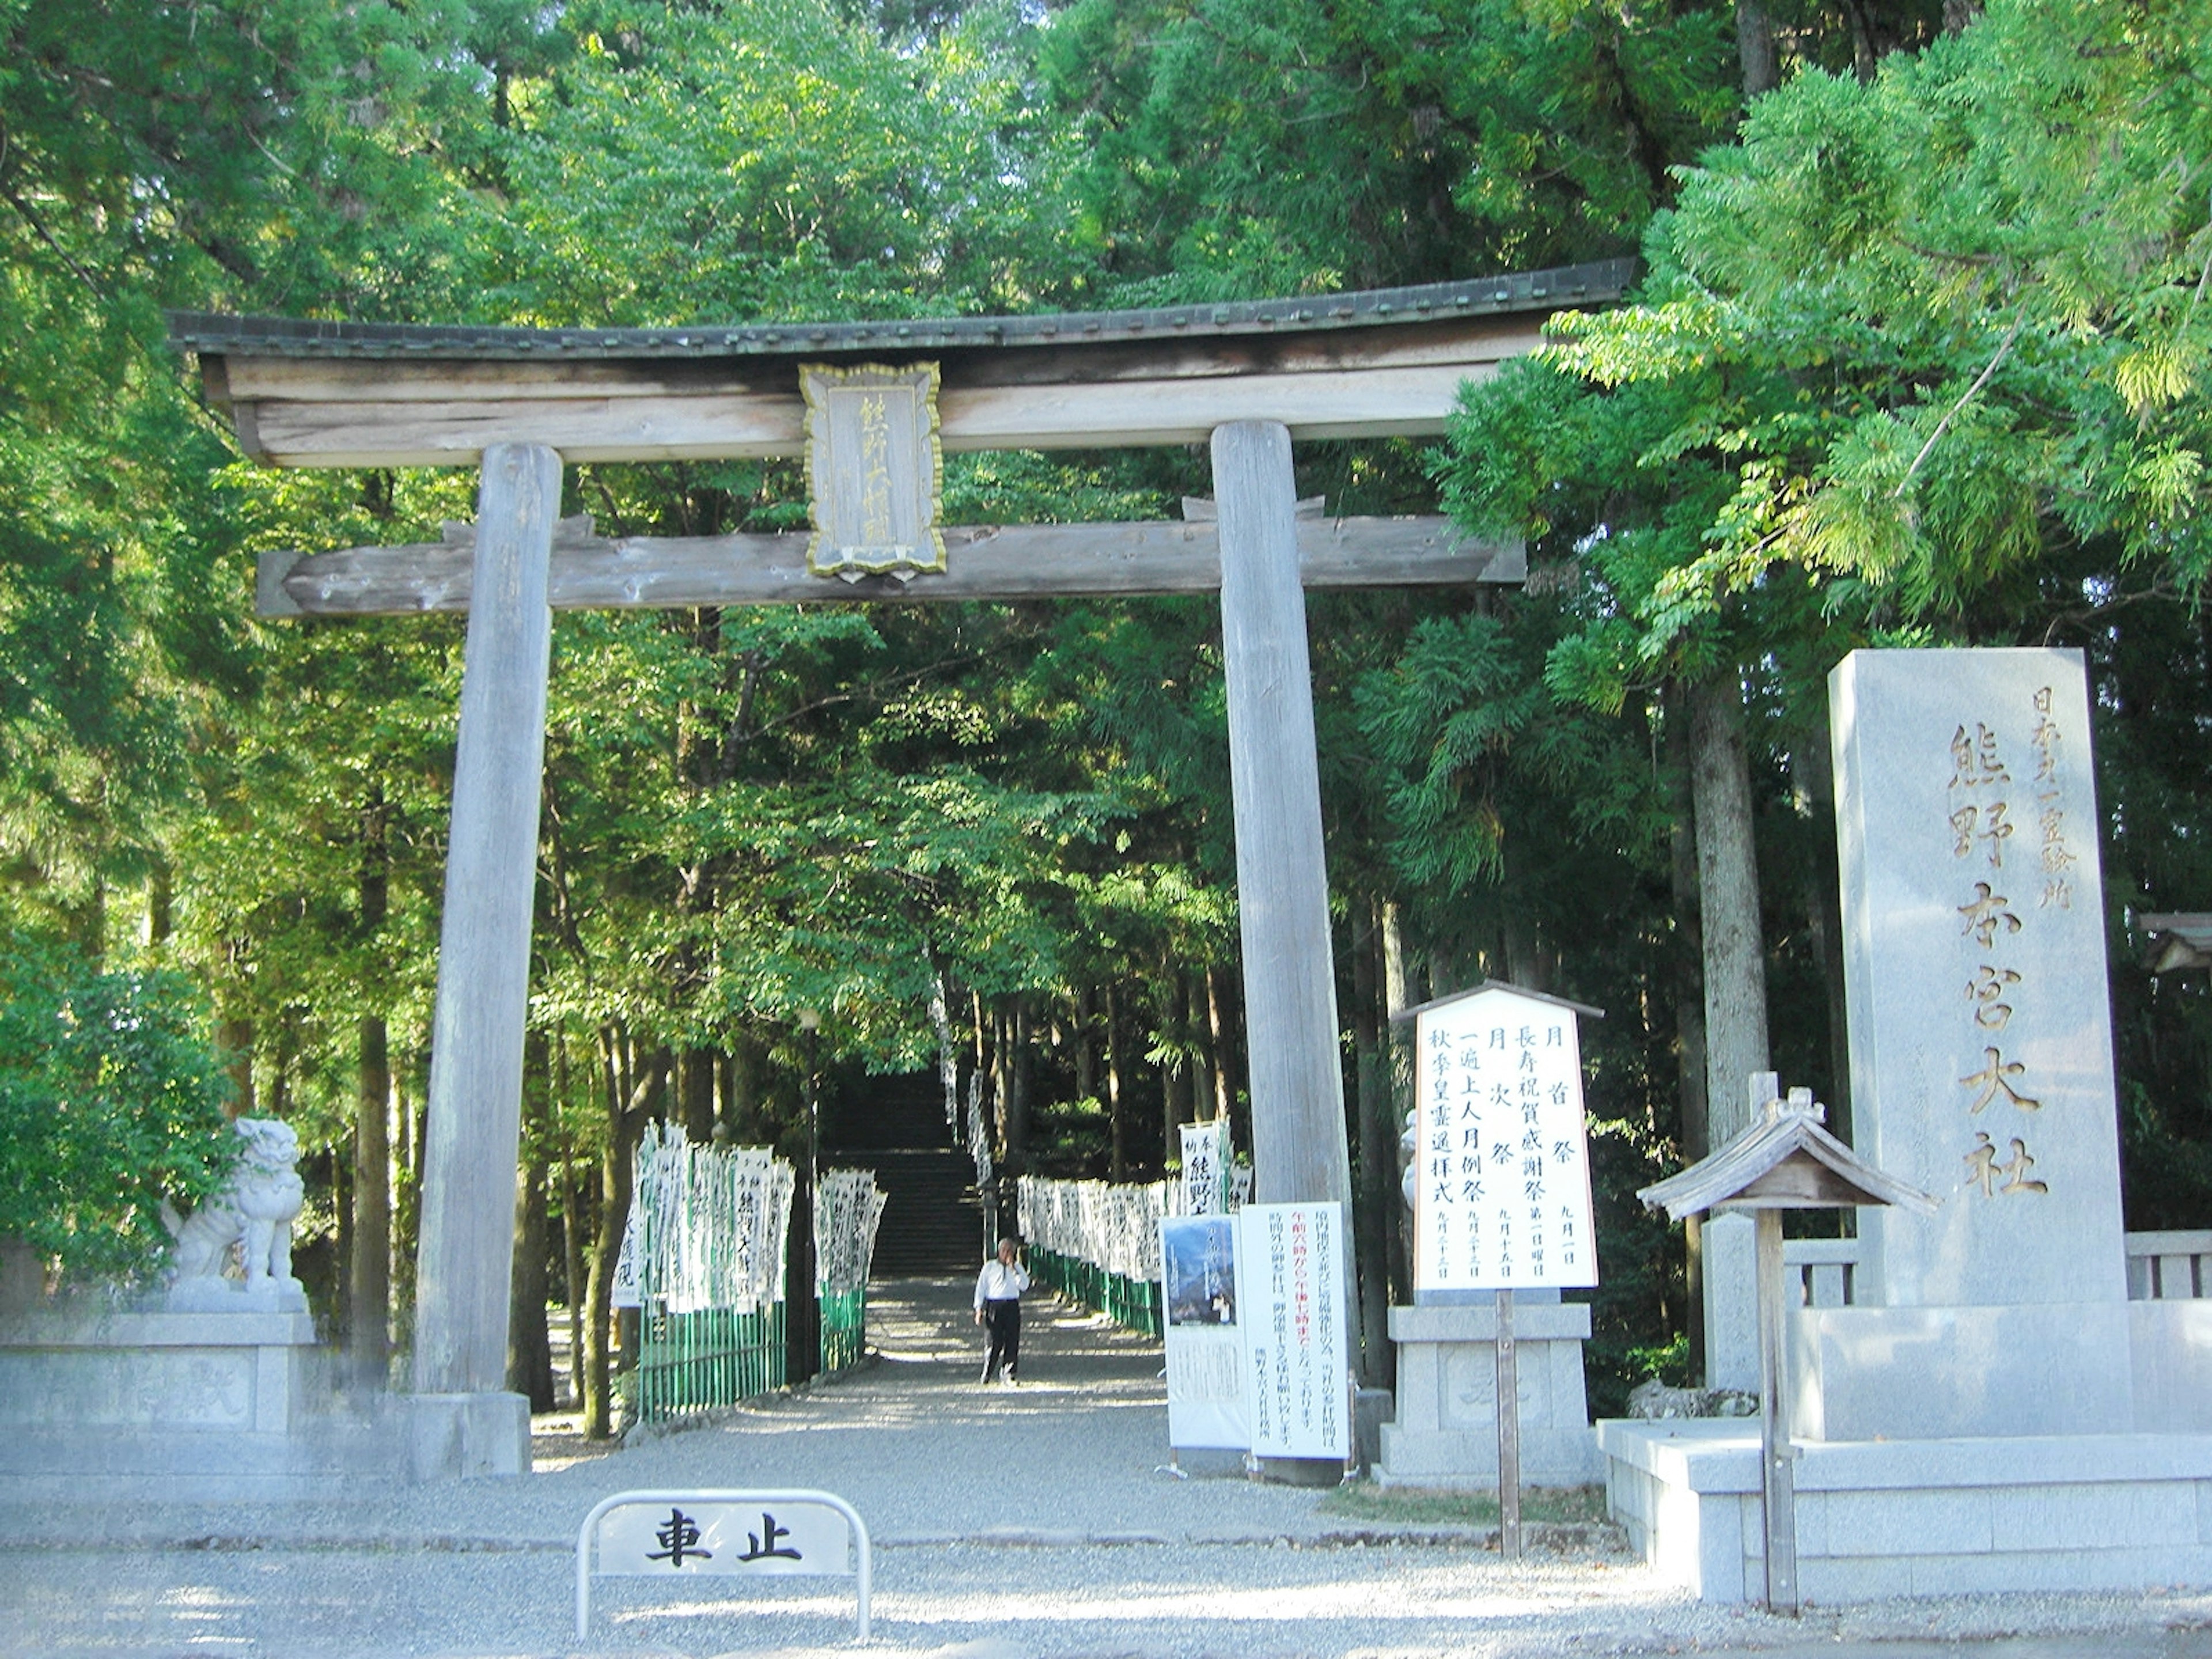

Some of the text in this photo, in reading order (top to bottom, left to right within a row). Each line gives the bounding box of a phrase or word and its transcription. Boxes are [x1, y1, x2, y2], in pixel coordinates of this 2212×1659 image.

[1946, 721, 2050, 1198] 熊野本宮大社
[1459, 1033, 1486, 1203] 一遍上人月例祭
[1488, 1028, 1516, 1278] 月次祭 九月十五日
[1515, 1027, 1547, 1203] 長寿祝賀感謝祭
[1560, 1205, 1575, 1265] 九月一日
[645, 1508, 803, 1568] 車止
